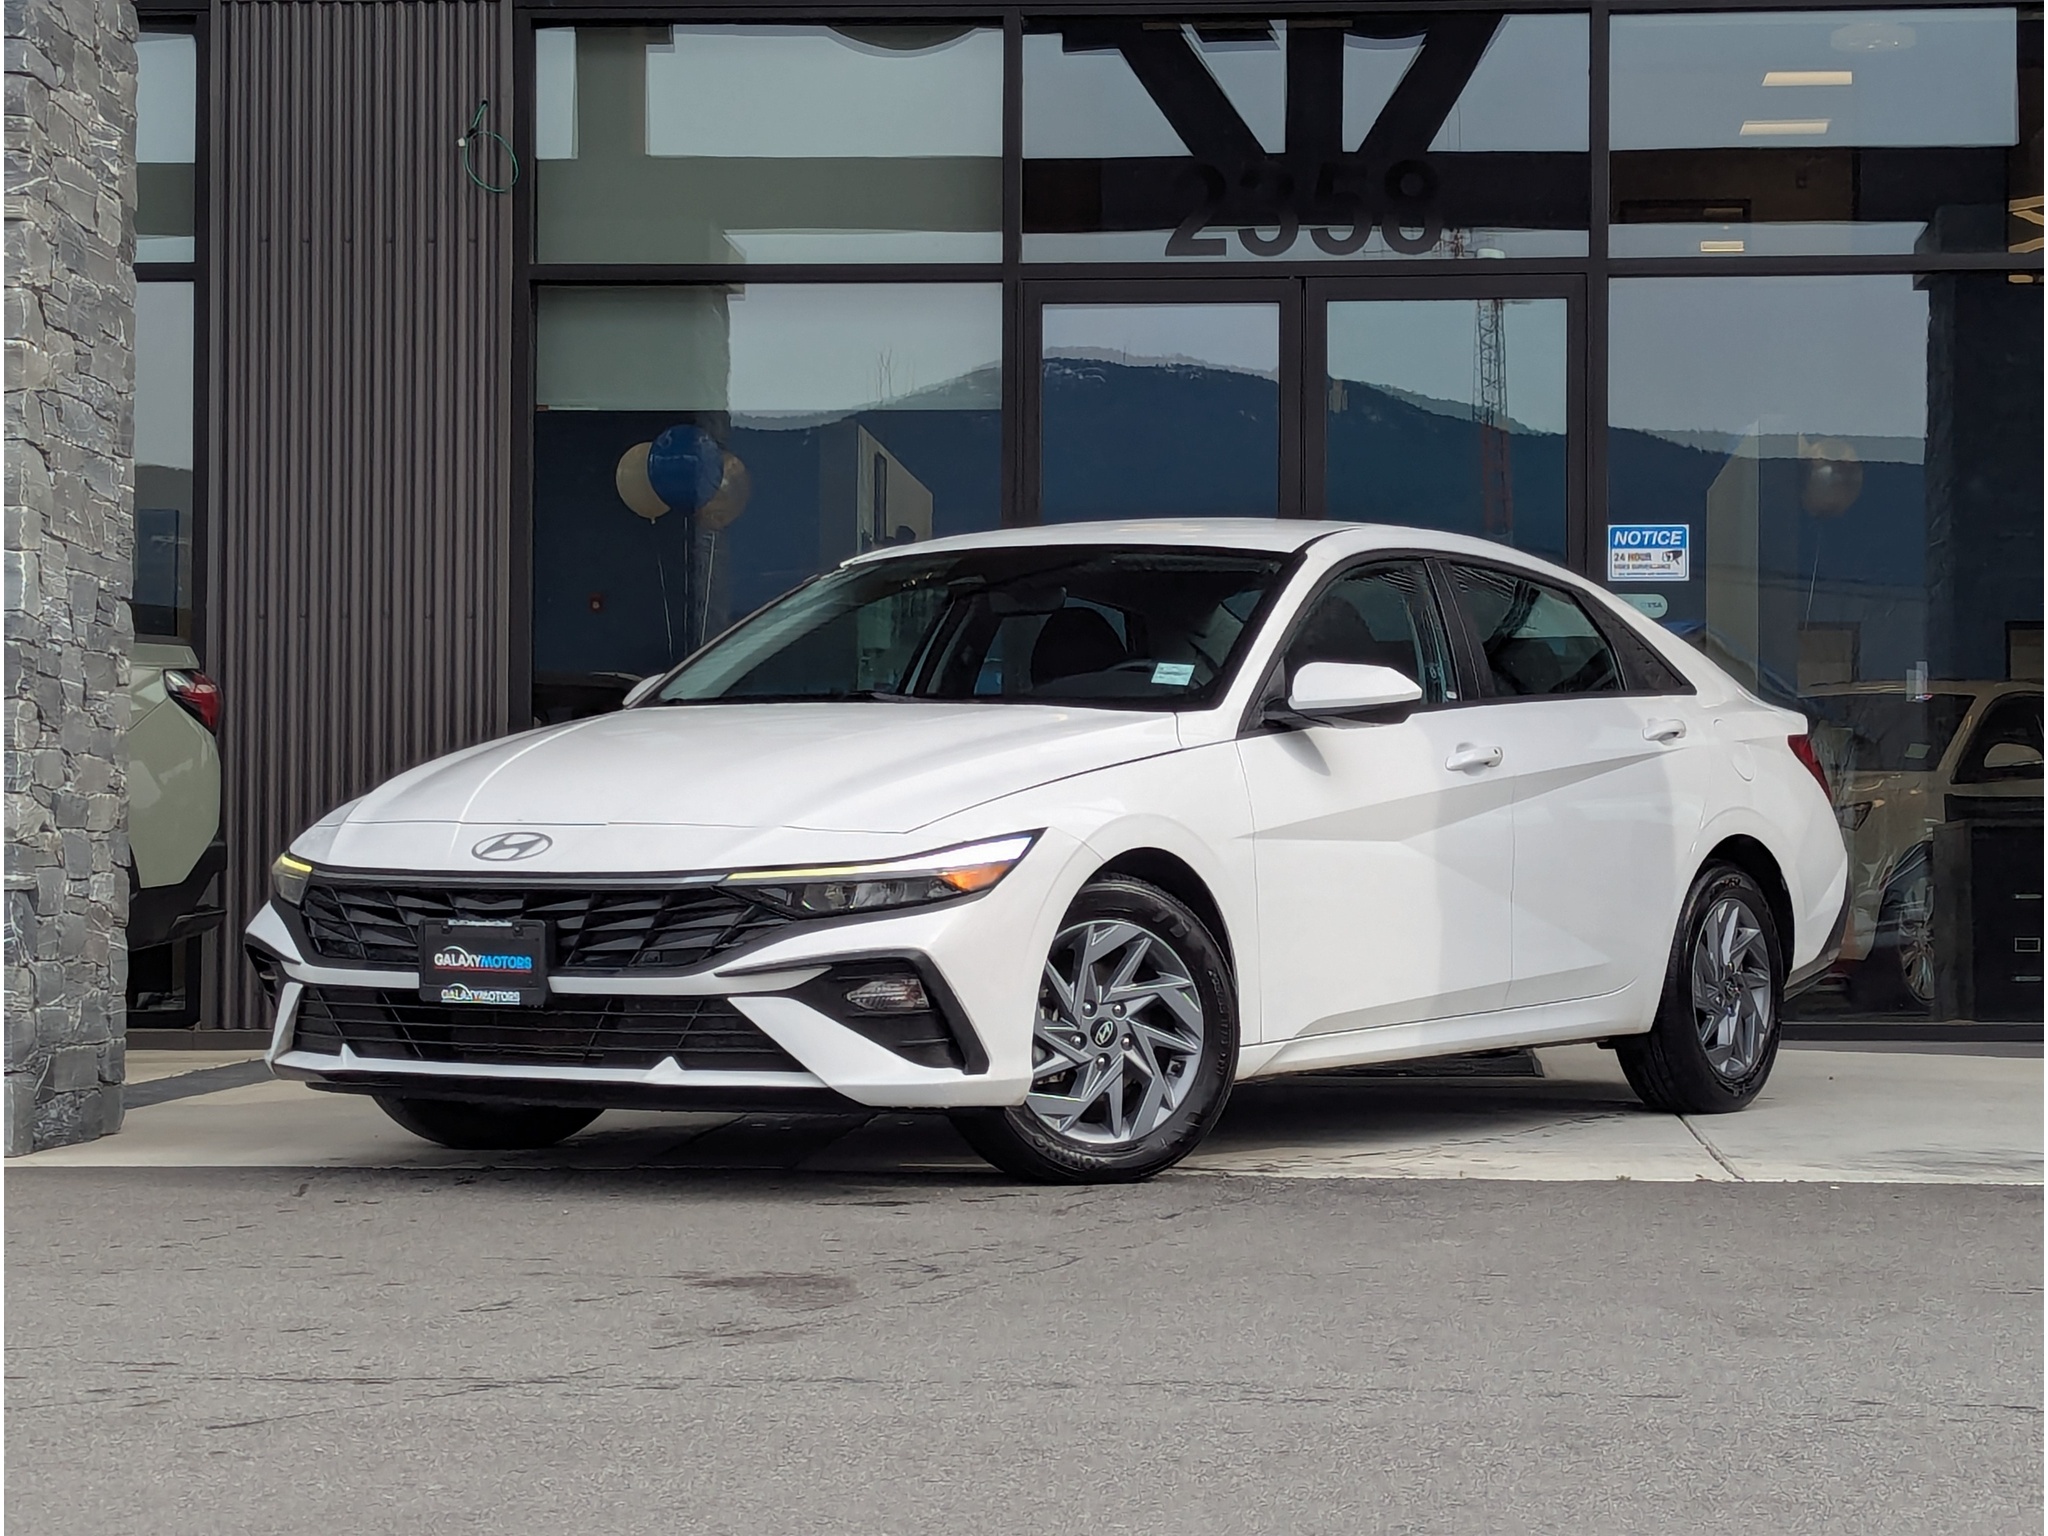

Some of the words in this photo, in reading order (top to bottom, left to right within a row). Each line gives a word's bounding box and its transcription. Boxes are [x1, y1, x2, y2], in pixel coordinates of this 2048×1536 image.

[1165, 159, 1443, 257] 2358
[1613, 530, 1683, 546] NOTICE
[1614, 552, 1626, 562] 24
[1628, 552, 1652, 562] HOUR
